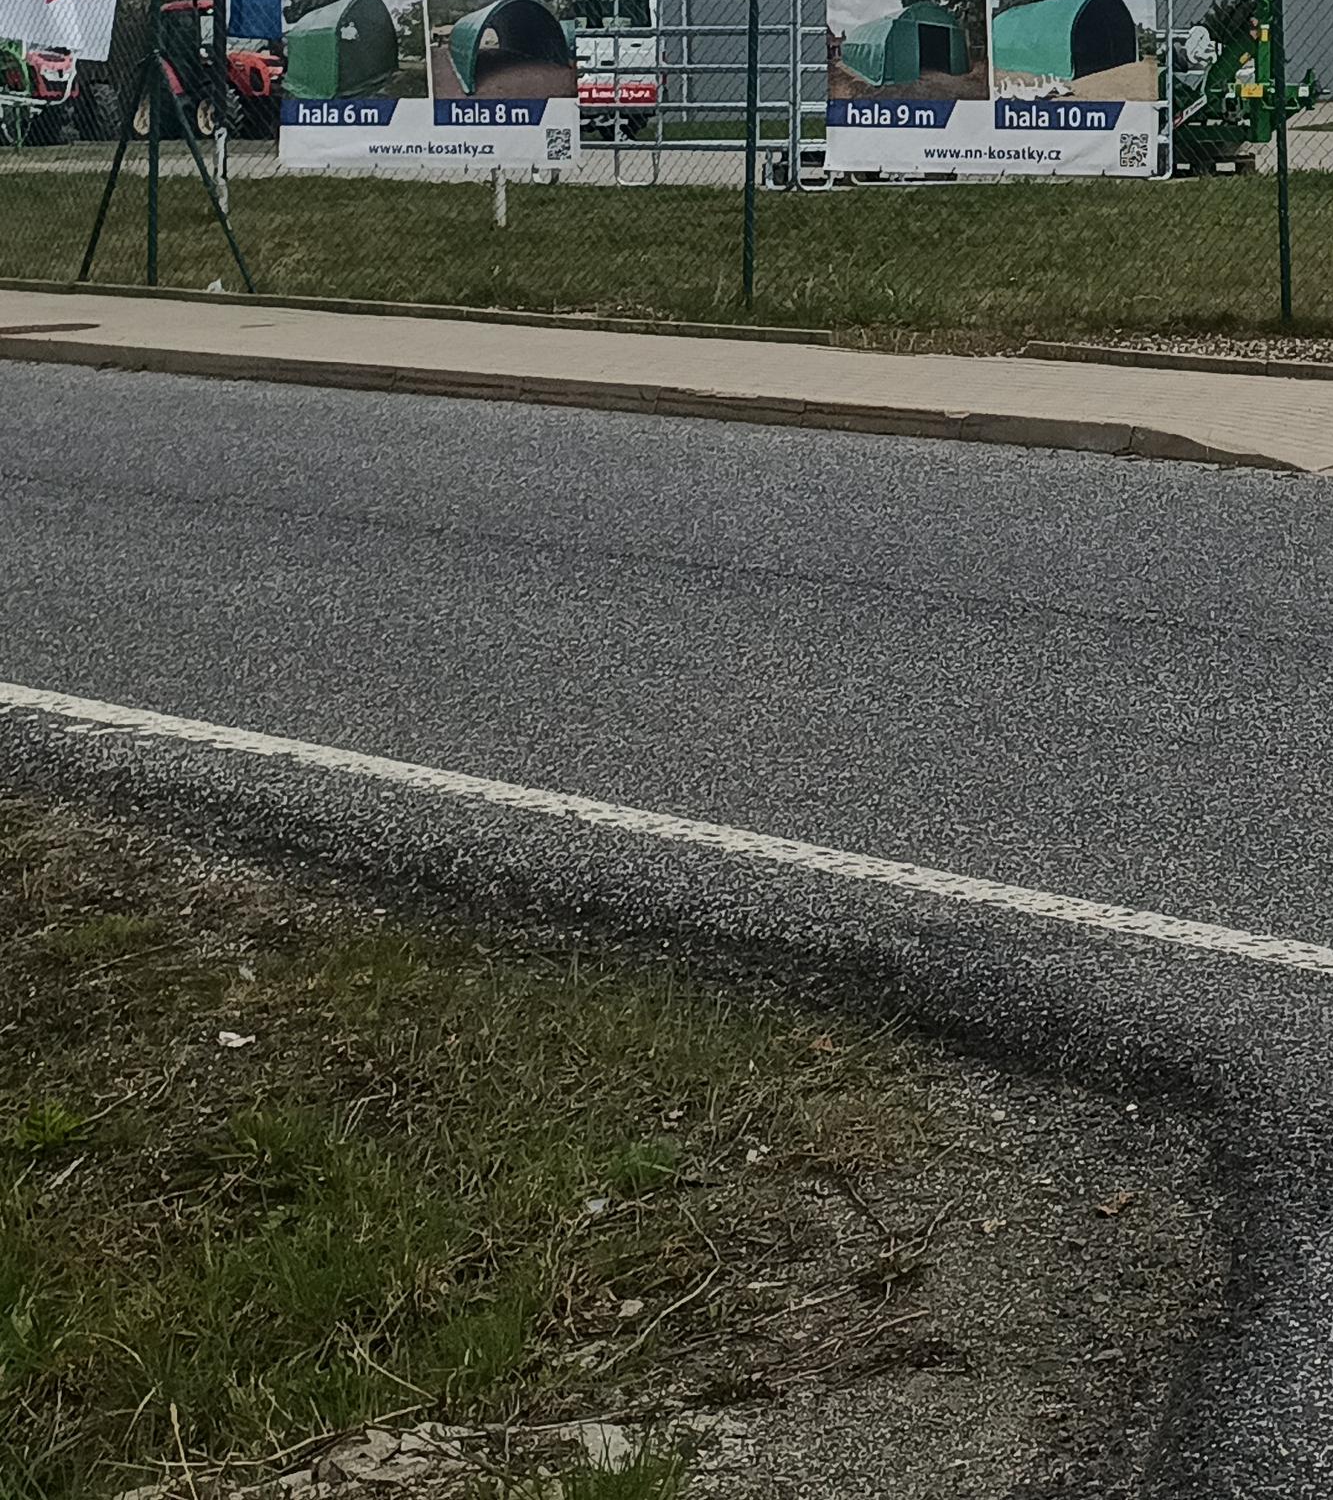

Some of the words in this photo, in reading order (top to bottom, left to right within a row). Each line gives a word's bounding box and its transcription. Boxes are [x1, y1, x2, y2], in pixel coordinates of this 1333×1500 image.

[299, 104, 338, 124] hala
[343, 105, 356, 123] 6
[360, 107, 379, 123] m
[451, 104, 487, 123] hala
[495, 104, 507, 123] 8
[511, 107, 530, 123] m
[847, 103, 891, 126] hala
[898, 105, 910, 126] 9
[915, 109, 935, 125] m
[1004, 104, 1049, 128] hala
[1056, 107, 1082, 128] 10
[1087, 110, 1106, 127] m
[369, 141, 495, 157] www.nn-kosatky.cz
[924, 145, 1061, 163] www.nn-kosatky.cz
